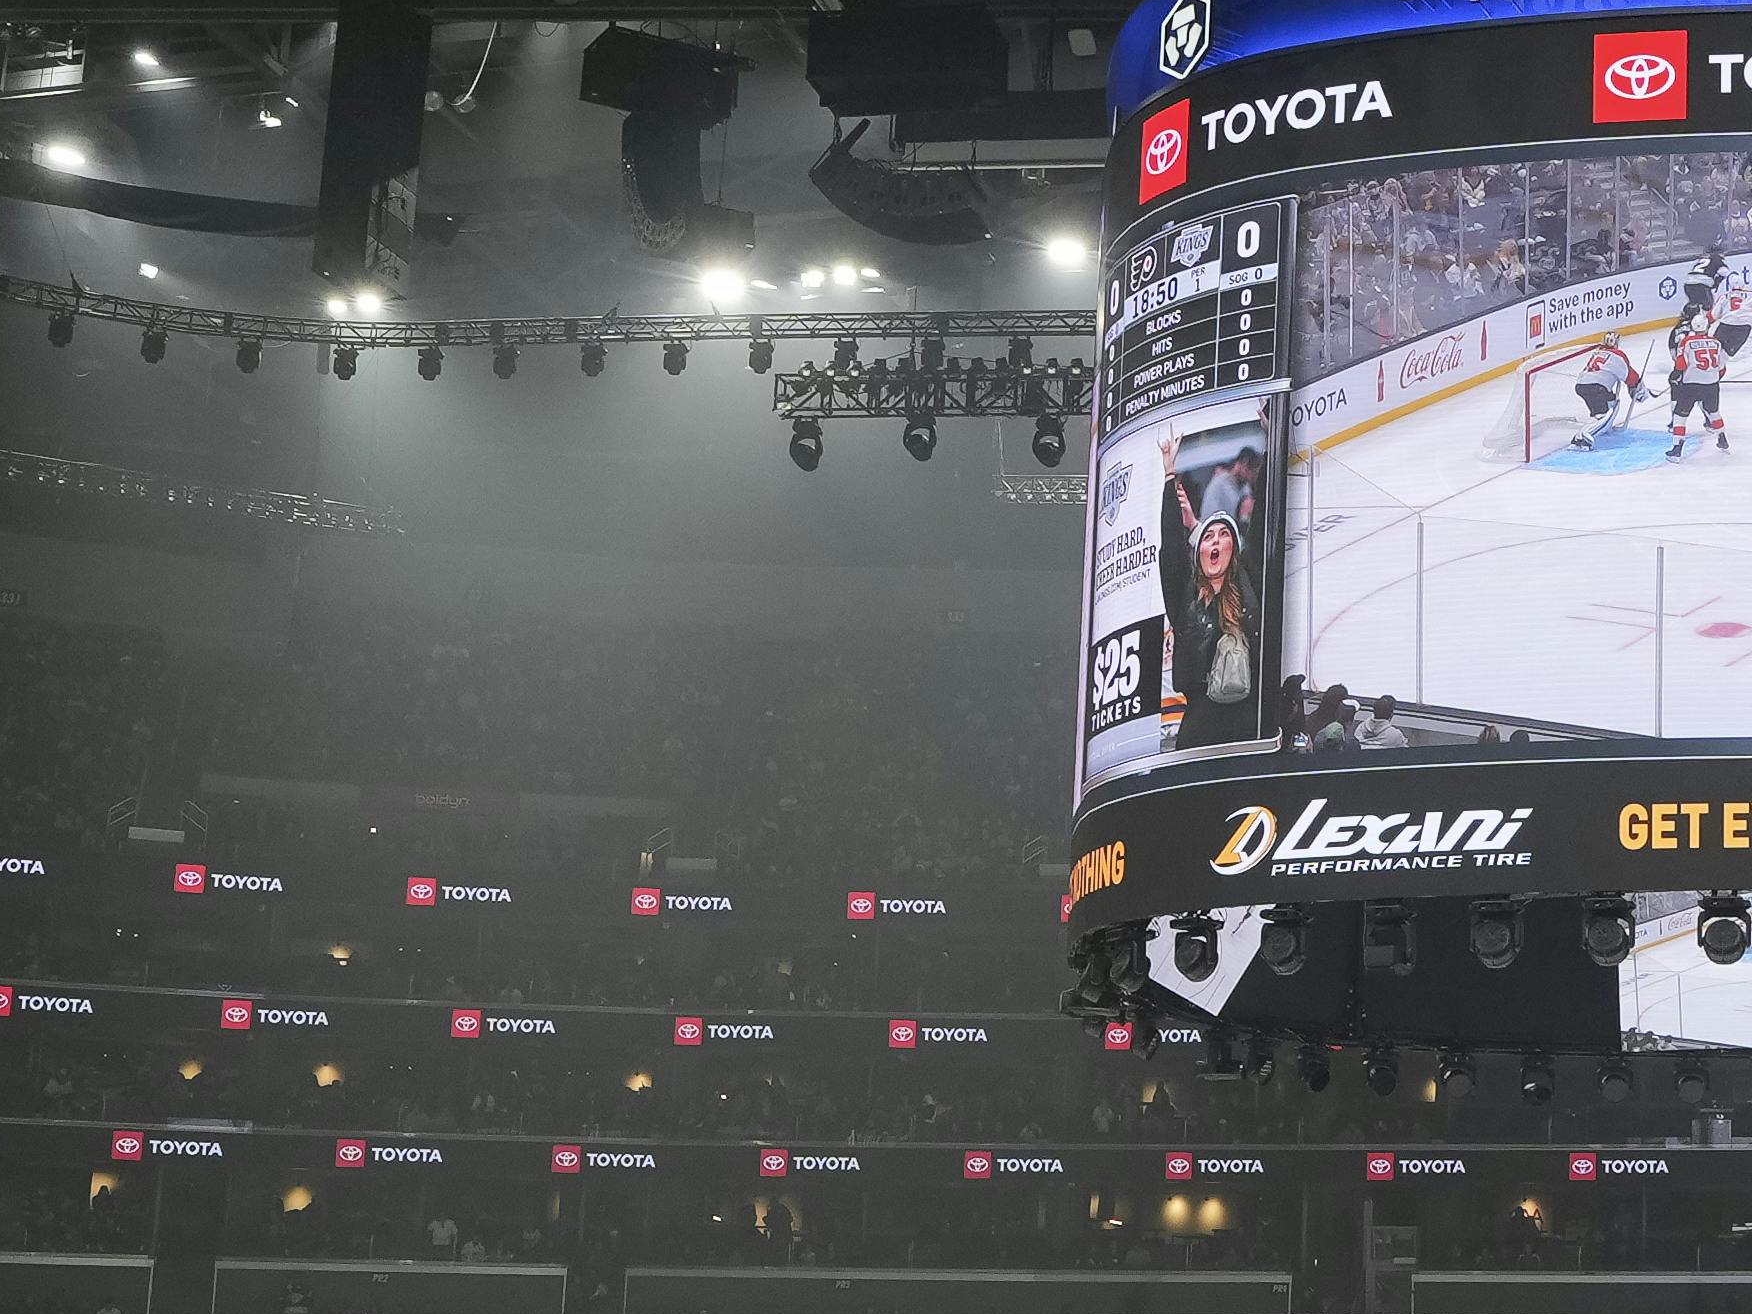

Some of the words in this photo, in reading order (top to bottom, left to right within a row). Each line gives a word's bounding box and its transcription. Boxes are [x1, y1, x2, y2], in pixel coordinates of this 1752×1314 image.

[1202, 80, 1391, 151] TOYOTA
[1237, 220, 1260, 259] 0
[1132, 277, 1178, 319] 18:50
[1549, 294, 1579, 313] Save
[1582, 281, 1630, 307] money
[1549, 313, 1578, 333] with
[1581, 309, 1602, 326] the
[1605, 299, 1634, 325] app
[1092, 696, 1141, 732] TICKETS
[1618, 803, 1710, 850] GET
[1271, 854, 1462, 877] PERFORMANCE
[1473, 852, 1532, 868] TIRE
[211, 874, 282, 891] TOYOTA
[442, 886, 511, 902] TOYOTA
[665, 896, 732, 910] TOYOTA
[880, 900, 946, 913] TOYOTA
[18, 996, 93, 1013] TOYOTA
[258, 1009, 328, 1025] TOYOTA
[486, 1018, 555, 1033] TOYOTA
[708, 1025, 773, 1038] TOYOTA
[922, 1028, 987, 1041] TOYOTA
[1198, 1160, 1263, 1172] TOYOTA
[1399, 1160, 1465, 1173] TOYOTA
